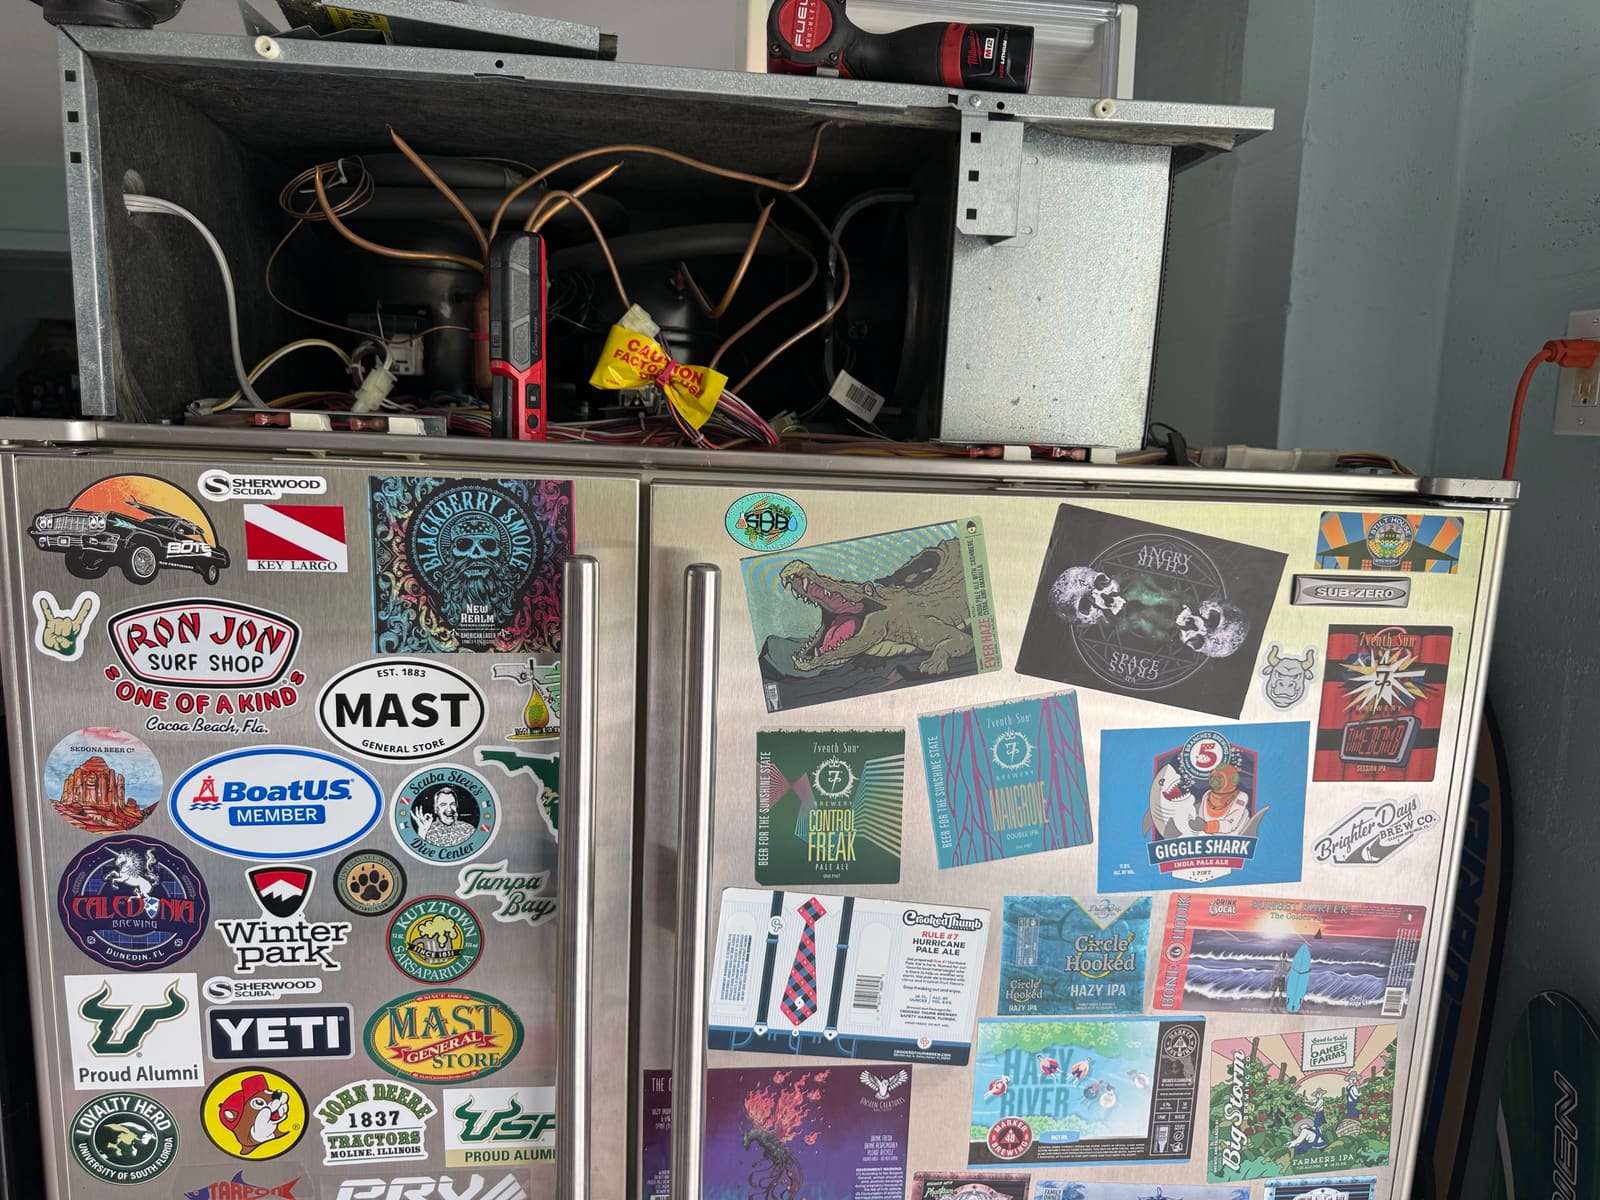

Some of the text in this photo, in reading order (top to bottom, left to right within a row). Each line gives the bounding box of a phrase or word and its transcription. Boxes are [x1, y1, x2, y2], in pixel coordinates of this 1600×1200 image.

[232, 478, 321, 491] SHERWOOD
[232, 488, 273, 496] SCUBA
[416, 491, 532, 572] BLACKBERRY SMOKE
[1390, 516, 1411, 537] HOUSE
[1138, 543, 1193, 566] ANGRY
[257, 560, 338, 572] KEY LARGO
[1316, 587, 1396, 598] SUB-ZERO
[126, 612, 287, 656] RON JON
[978, 617, 992, 642] HAZE
[148, 653, 265, 673] SURF SHOP
[982, 640, 997, 669] EVER
[1112, 650, 1160, 672] SPACE
[377, 668, 426, 678] EST. 1883
[175, 694, 209, 714] OF
[216, 694, 234, 714] A
[335, 693, 470, 728] MAST
[146, 716, 269, 735] Cocoa Beach, Fla.
[361, 737, 446, 753] GENERAL STORE
[813, 742, 839, 753] 7venth
[1195, 742, 1218, 769] 5
[409, 770, 483, 797] Scuba Steve's
[927, 735, 953, 849] BEER FOR THE SUNSHINE STATE
[237, 808, 318, 823] MEMBER
[758, 751, 771, 866] BEER FOR THE SUNSHINE STATE
[988, 781, 1049, 832] MANGROVE
[809, 809, 857, 832] CONTROL
[1314, 798, 1417, 862] Brighter Days
[1379, 813, 1437, 840] BREW CO.
[1006, 829, 1040, 841] DOUBLE IPA
[409, 837, 475, 860] Dive Center
[808, 831, 857, 862] FREAK
[1155, 839, 1251, 859] GIGGLE SHARK
[815, 863, 832, 871] PALE
[1174, 860, 1194, 868] INDIA
[1195, 859, 1214, 867] PALE
[463, 867, 542, 894] Tampa
[501, 891, 556, 922] Bay
[1213, 898, 1236, 906] DRINK
[112, 919, 158, 929] BREWING
[396, 901, 478, 938] KUTZTOWN
[903, 910, 982, 932] Crooked Thumb
[217, 921, 350, 945] Winter
[921, 930, 959, 941] RULE #7
[1074, 933, 1129, 953] Circle
[912, 938, 966, 949] HURRICANE
[915, 945, 961, 956] PALE ALE
[1160, 895, 1191, 1009] BONE HOOK
[237, 942, 338, 971] park
[393, 945, 475, 980] SARSAPARILLA
[1064, 953, 1136, 973] Hooked
[234, 980, 316, 991] SHERWOOD
[1009, 978, 1040, 989] Circle
[1070, 983, 1126, 997] HAZY IPA
[1005, 989, 1043, 999] Hooked
[1008, 1004, 1038, 1012] HAZY IPA
[216, 1015, 340, 1051] YETI
[386, 1003, 501, 1049] MAST
[406, 1031, 482, 1063] GENERAL
[1310, 1043, 1346, 1058] OAKES
[432, 1052, 501, 1069] STORE
[1311, 1051, 1347, 1066] FARMS
[79, 1064, 199, 1083] Proud Alumni
[651, 1077, 665, 1092] THE
[318, 1082, 433, 1125] JOHN DEERE
[1001, 1087, 1071, 1119] RIVER
[1222, 1049, 1248, 1171] Big Storm
[75, 1096, 172, 1137] LOYALTY HERD
[348, 1110, 400, 1128] 1837
[994, 1119, 1027, 1133] MARKER
[327, 1131, 421, 1149] TRACTORS
[991, 1140, 1029, 1157] BREWING
[78, 1136, 174, 1181] UNIVERSITY OF SOUTH FLORIDA
[330, 1146, 421, 1159] MOLINE, ILLINOIS
[464, 1149, 556, 1163] PROUD ALUM
[1292, 1156, 1336, 1167] FARMERS
[1339, 1153, 1354, 1161] IPA
